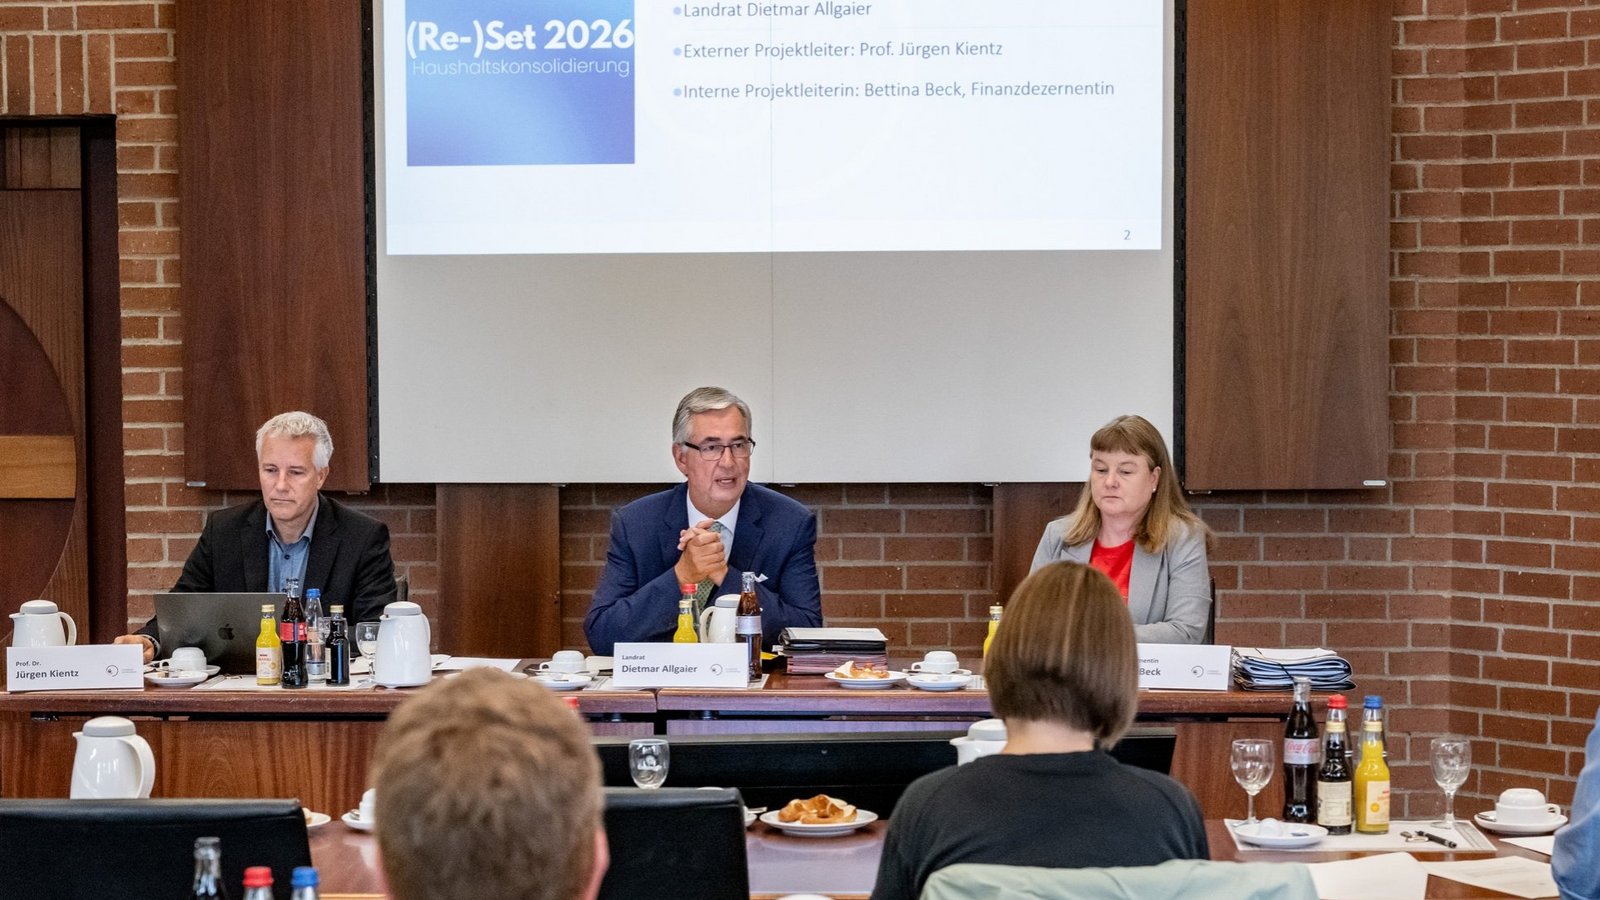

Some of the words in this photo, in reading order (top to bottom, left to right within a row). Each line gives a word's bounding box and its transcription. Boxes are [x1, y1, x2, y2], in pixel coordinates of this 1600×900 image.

[683, 2, 742, 17] Landrat
[747, 2, 810, 17] Dietmar
[814, 1, 872, 19] Allgaier
[406, 20, 536, 59] (Re-)Set
[544, 19, 634, 49] 2026
[683, 43, 750, 58] Externer
[755, 42, 855, 60] Projektleiter:
[860, 41, 894, 56] Prof.
[899, 42, 950, 60] Jürgen
[955, 41, 1003, 56] Kientz
[412, 59, 630, 78] Haushaltskonsolidierung
[683, 84, 740, 98] Interne
[745, 83, 859, 101] Projektleiterin:
[864, 82, 919, 97] Bettina
[925, 81, 966, 98] Beck,
[971, 81, 1115, 96] Finanzdezernentin
[1123, 229, 1131, 241] 2
[15, 670, 47, 680] Jürgen
[49, 670, 79, 678] Kientz
[621, 664, 660, 673] Dietmar
[661, 664, 698, 675] Allgaier
[1140, 668, 1161, 676] Beck
